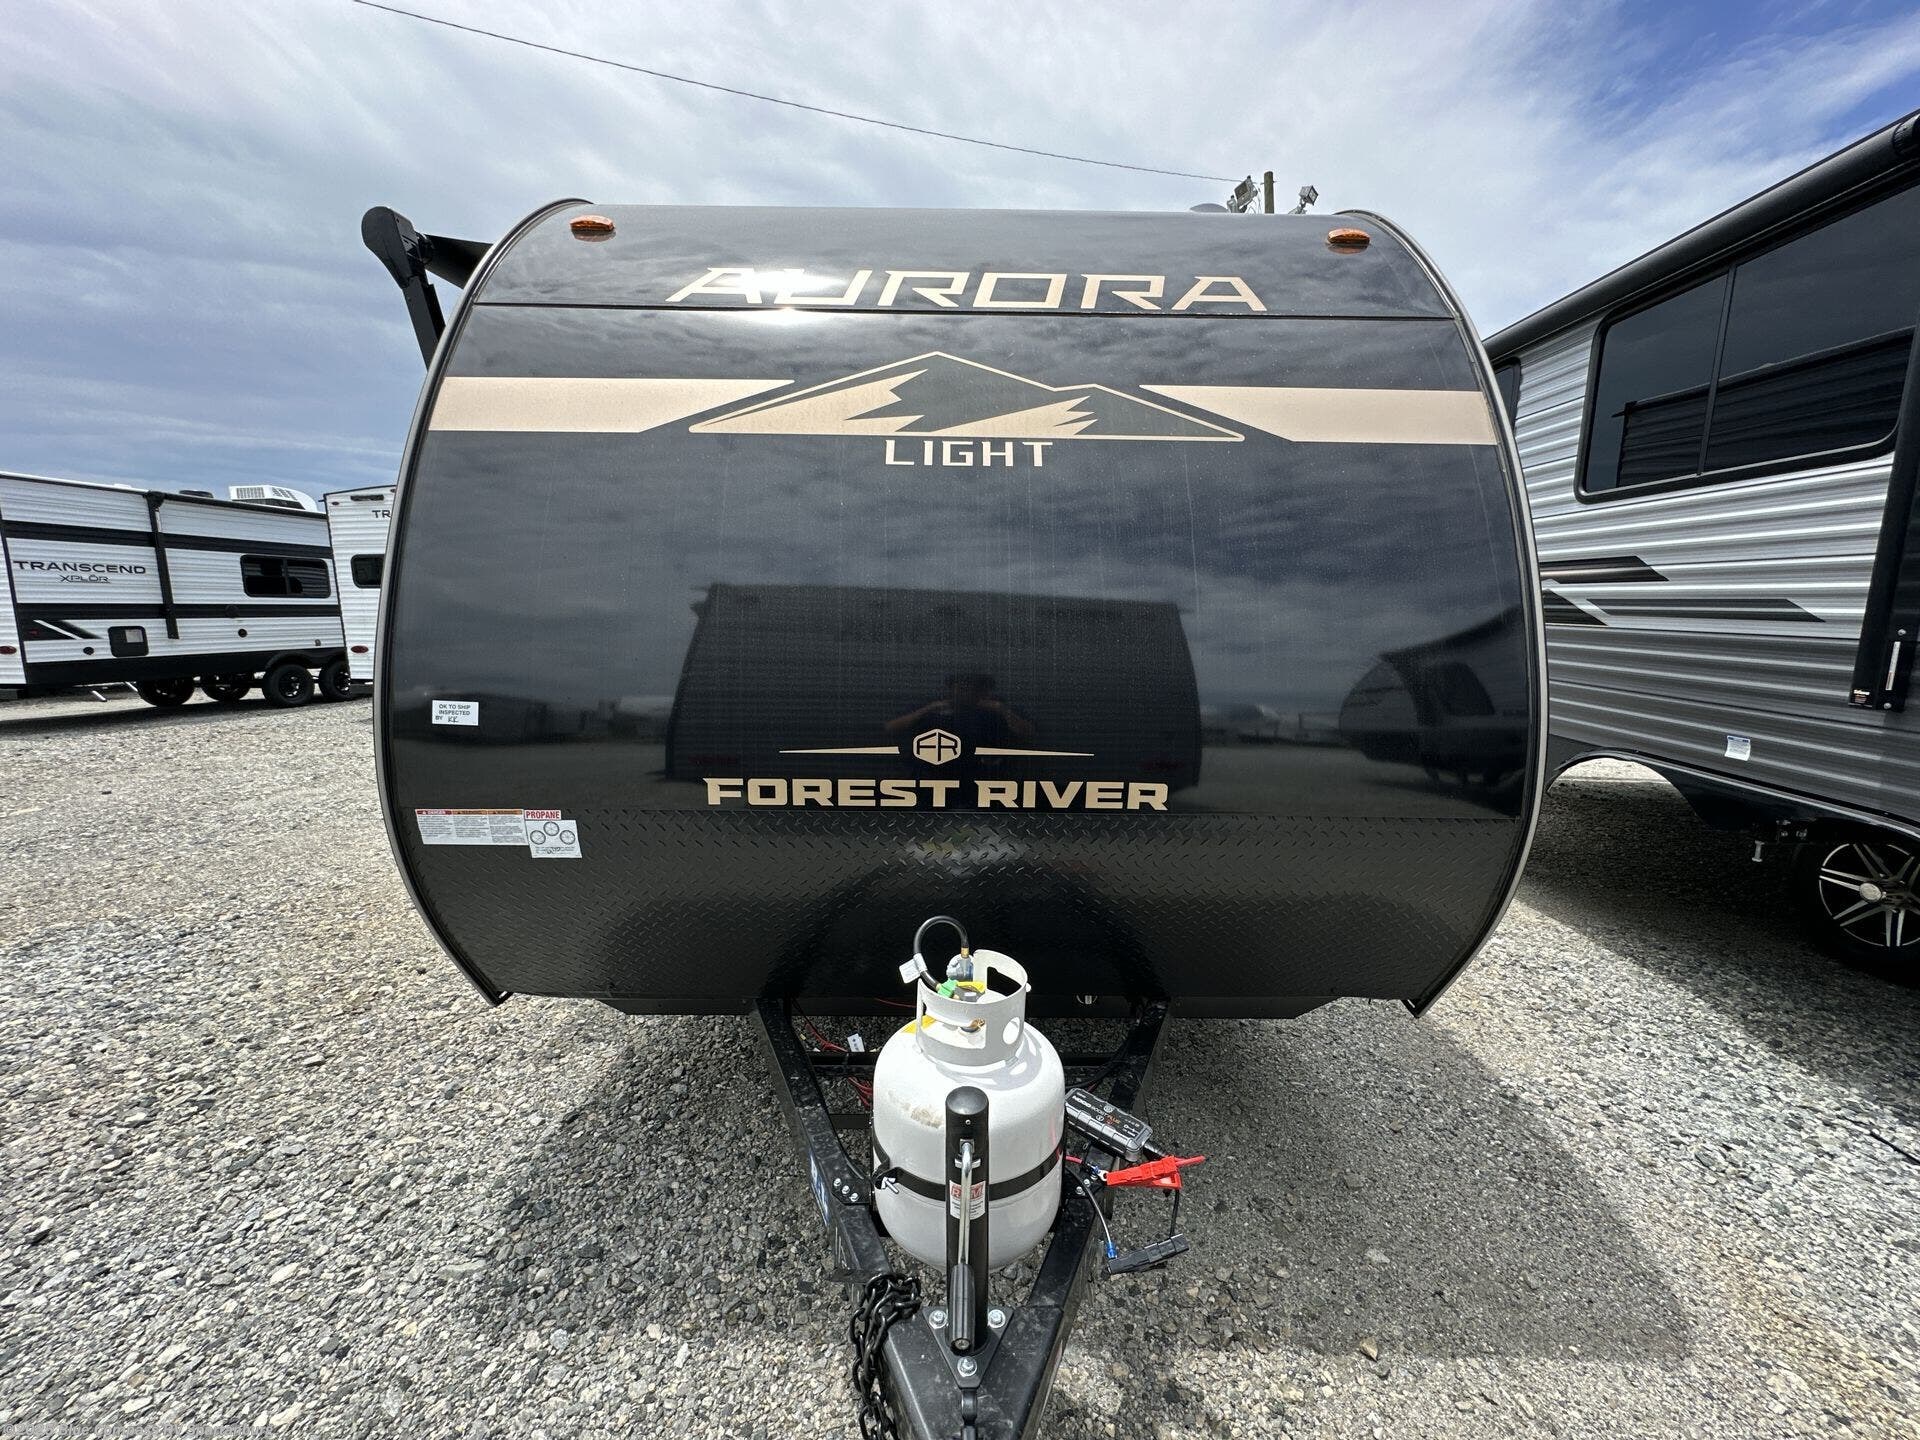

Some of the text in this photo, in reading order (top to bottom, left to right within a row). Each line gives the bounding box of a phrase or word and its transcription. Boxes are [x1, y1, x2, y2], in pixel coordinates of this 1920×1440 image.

[665, 267, 1268, 312] AURORA
[885, 440, 1054, 468] LIGHT
[13, 561, 146, 574] TRANSCEND
[703, 777, 1169, 811] FOREST RIVER
[526, 811, 560, 819] PROPANE
